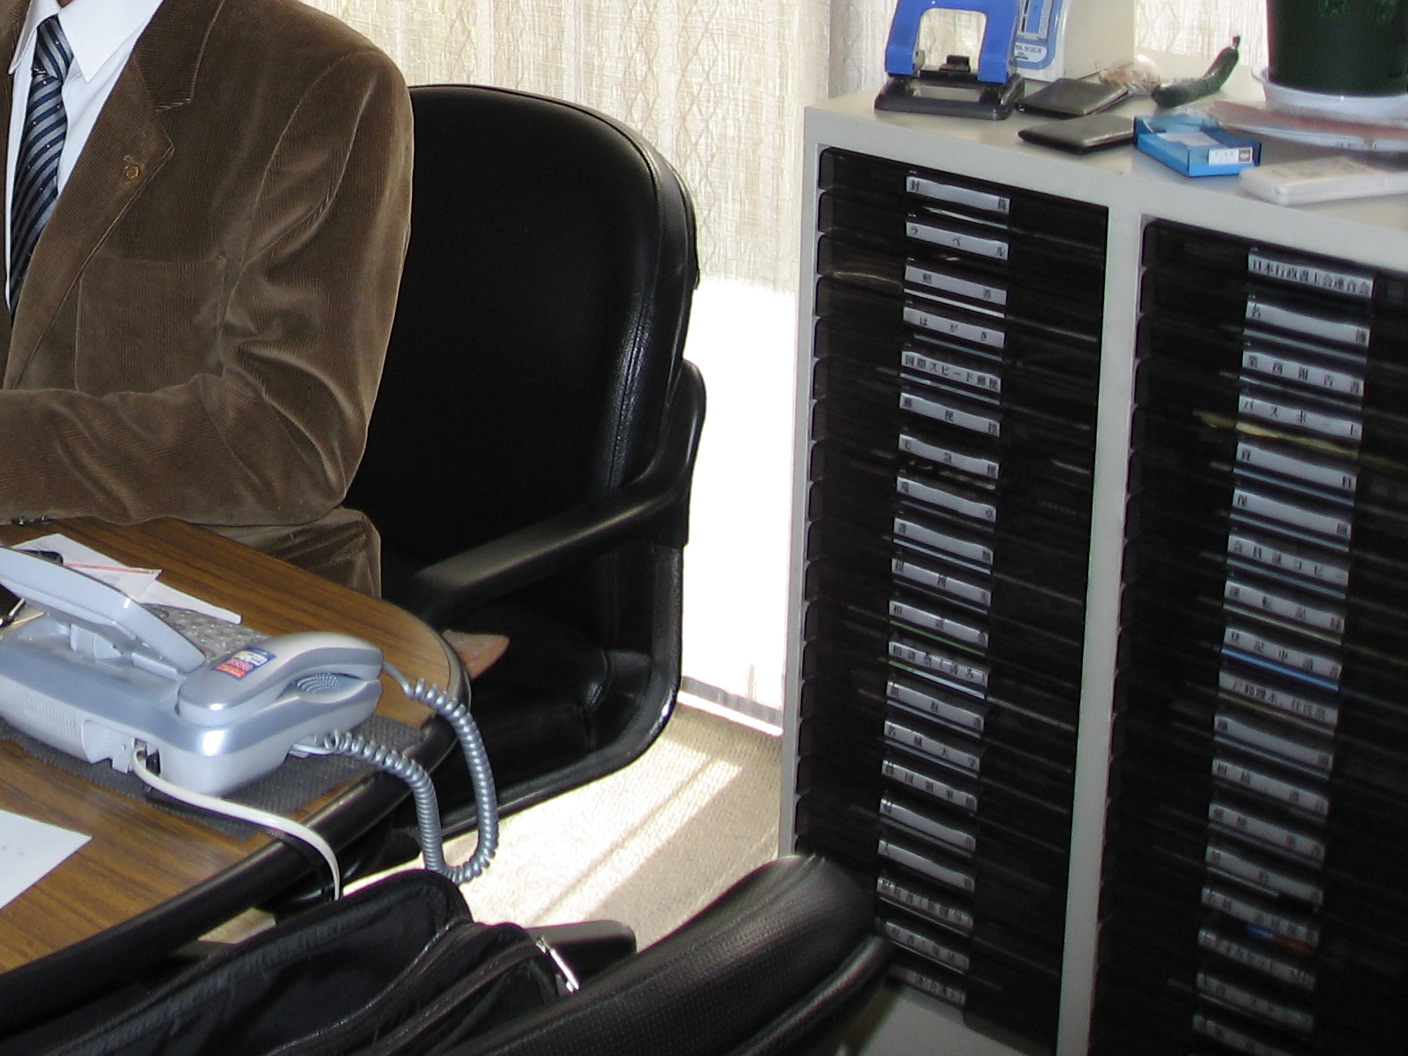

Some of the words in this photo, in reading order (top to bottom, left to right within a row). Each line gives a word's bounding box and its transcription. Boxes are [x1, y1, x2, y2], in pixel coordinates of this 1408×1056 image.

[911, 226, 1005, 257] ラベル
[1252, 259, 1371, 295] 日本行政書士会連合会
[919, 315, 988, 342] はがき
[905, 354, 1000, 391] 国際スピード郵便
[1249, 355, 1360, 394] 業務報告書
[1244, 400, 1354, 436] パスポート
